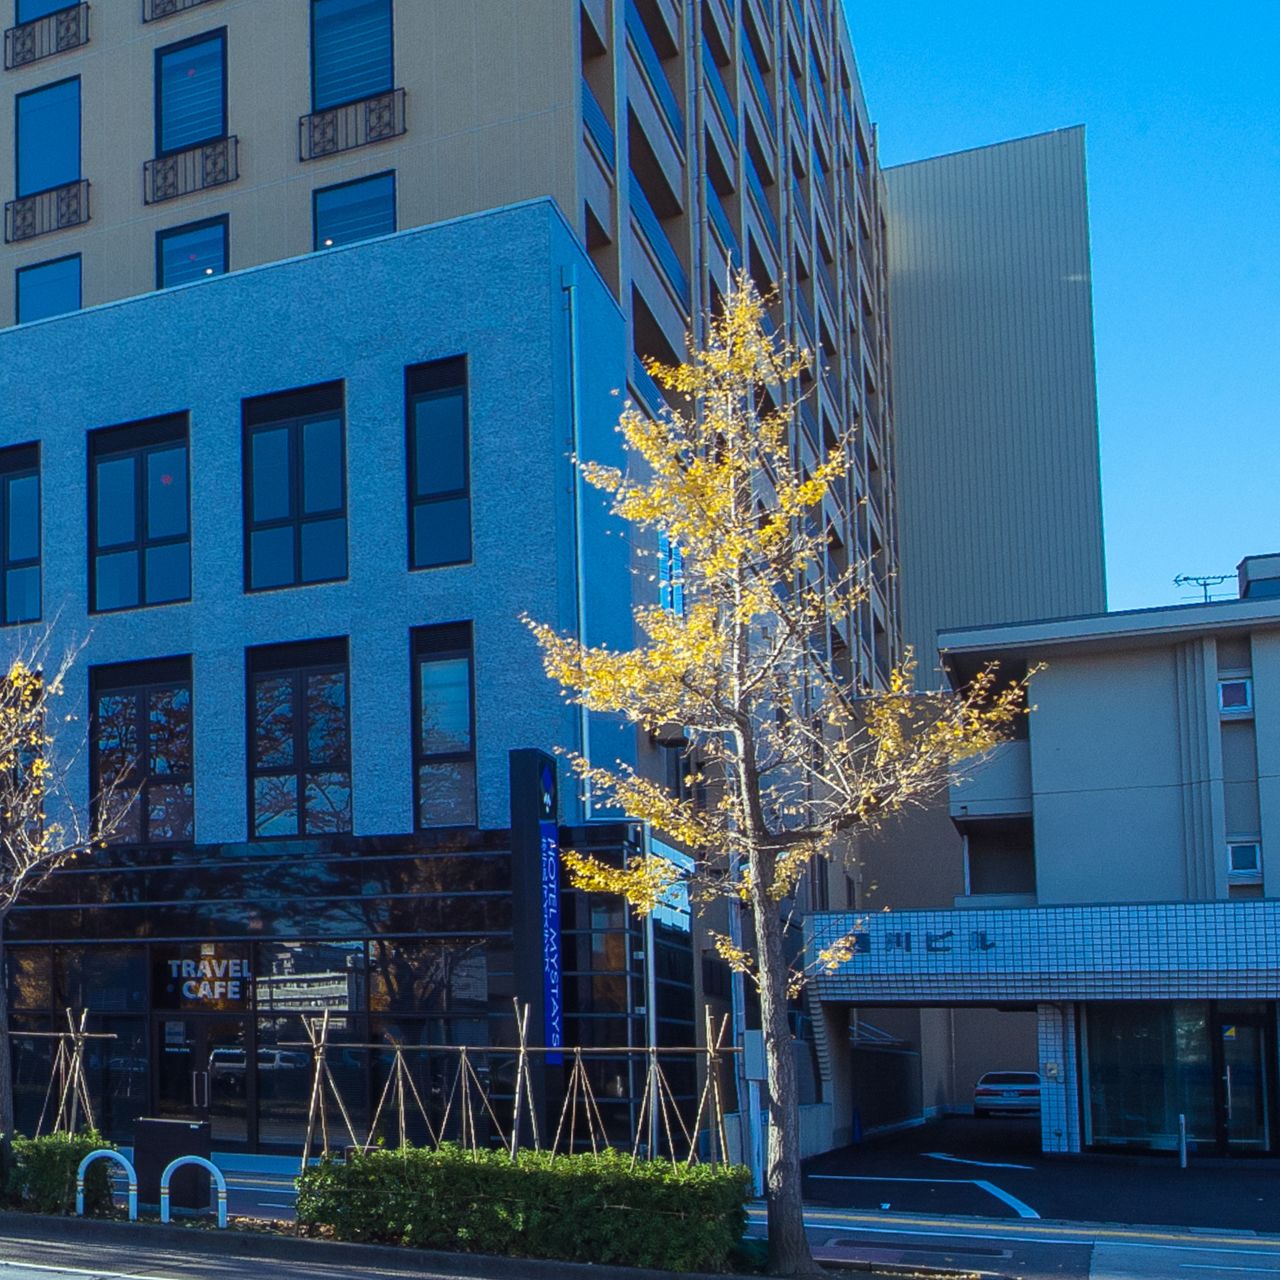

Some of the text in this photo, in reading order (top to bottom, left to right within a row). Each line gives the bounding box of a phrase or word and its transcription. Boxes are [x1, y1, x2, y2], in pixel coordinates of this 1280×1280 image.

[547, 837, 560, 1047] HOTEL MYSTAYS
[167, 959, 252, 978] TRAVEL
[182, 980, 241, 1000] CAFE
